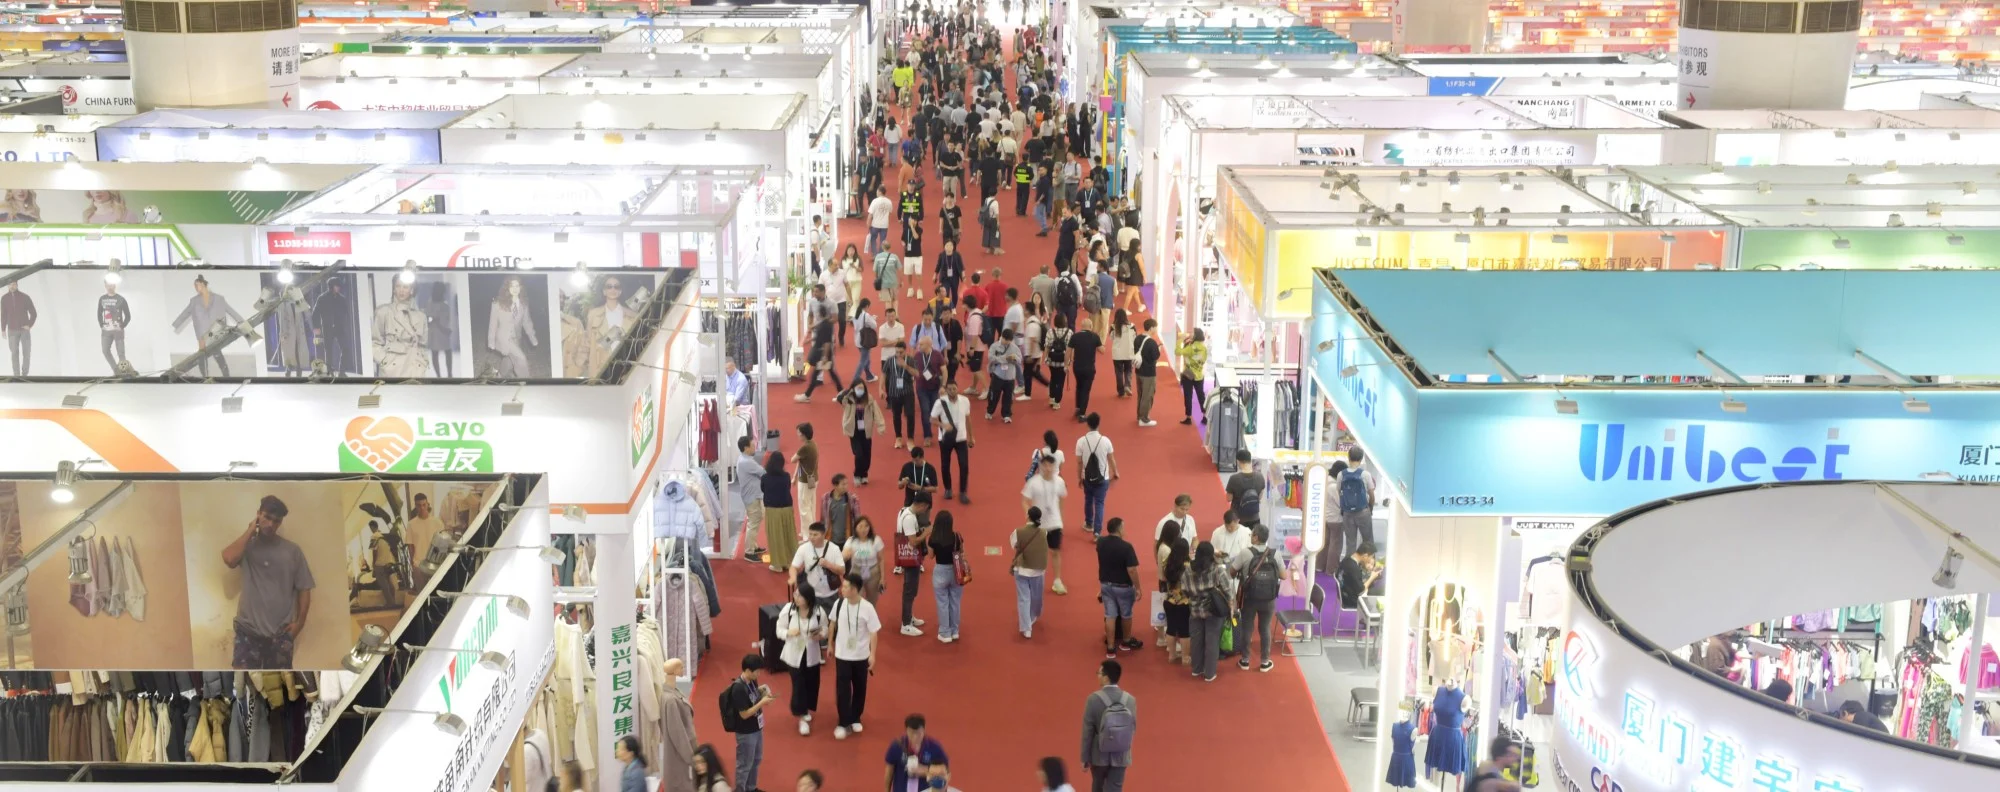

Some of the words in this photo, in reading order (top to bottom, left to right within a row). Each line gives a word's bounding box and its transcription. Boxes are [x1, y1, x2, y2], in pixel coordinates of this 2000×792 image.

[271, 46, 291, 58] MORE
[85, 97, 111, 105] CHINA
[417, 417, 485, 440] Layo
[416, 447, 484, 471] 良友
[1579, 424, 1850, 483] Unibest
[1309, 482, 1321, 534] UNIBEST
[1439, 496, 1494, 505] 1.1C33-34
[611, 624, 633, 759] 嘉兴良友集
